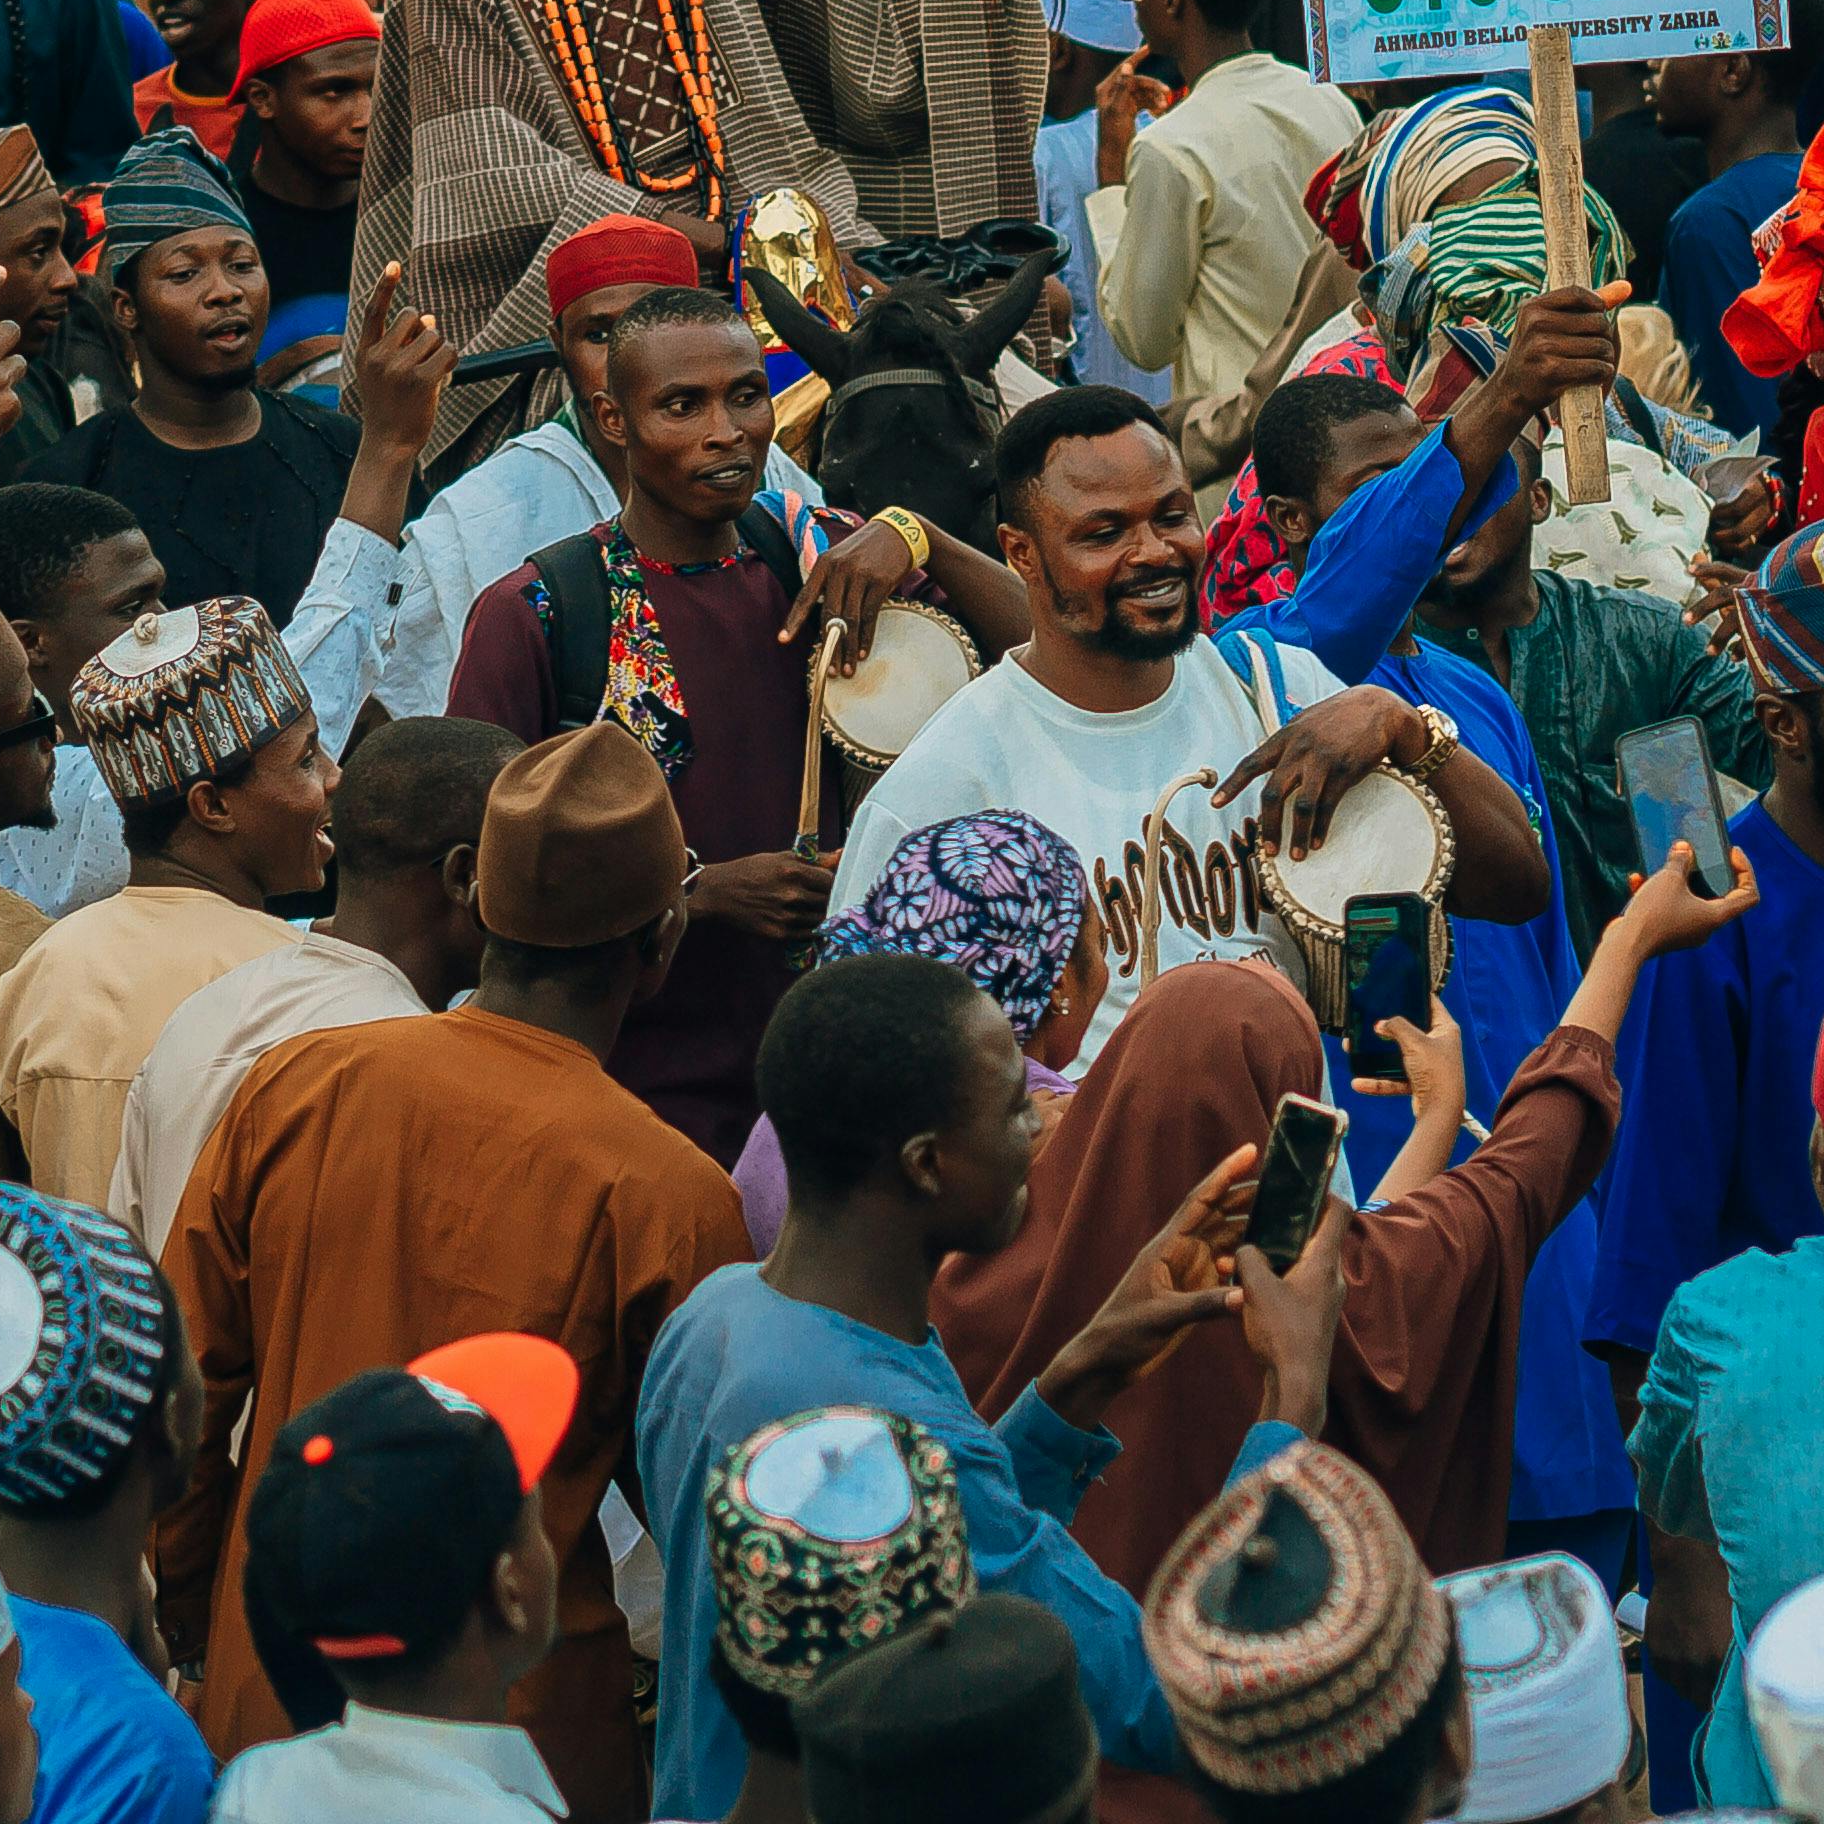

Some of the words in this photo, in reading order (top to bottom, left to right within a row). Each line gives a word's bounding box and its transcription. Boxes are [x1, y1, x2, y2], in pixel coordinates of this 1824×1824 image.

[1374, 29, 1457, 53] AHMADU
[1463, 24, 1529, 48] BELLO
[1533, 14, 1654, 38] VERSITY
[1659, 10, 1721, 32] ZARIA
